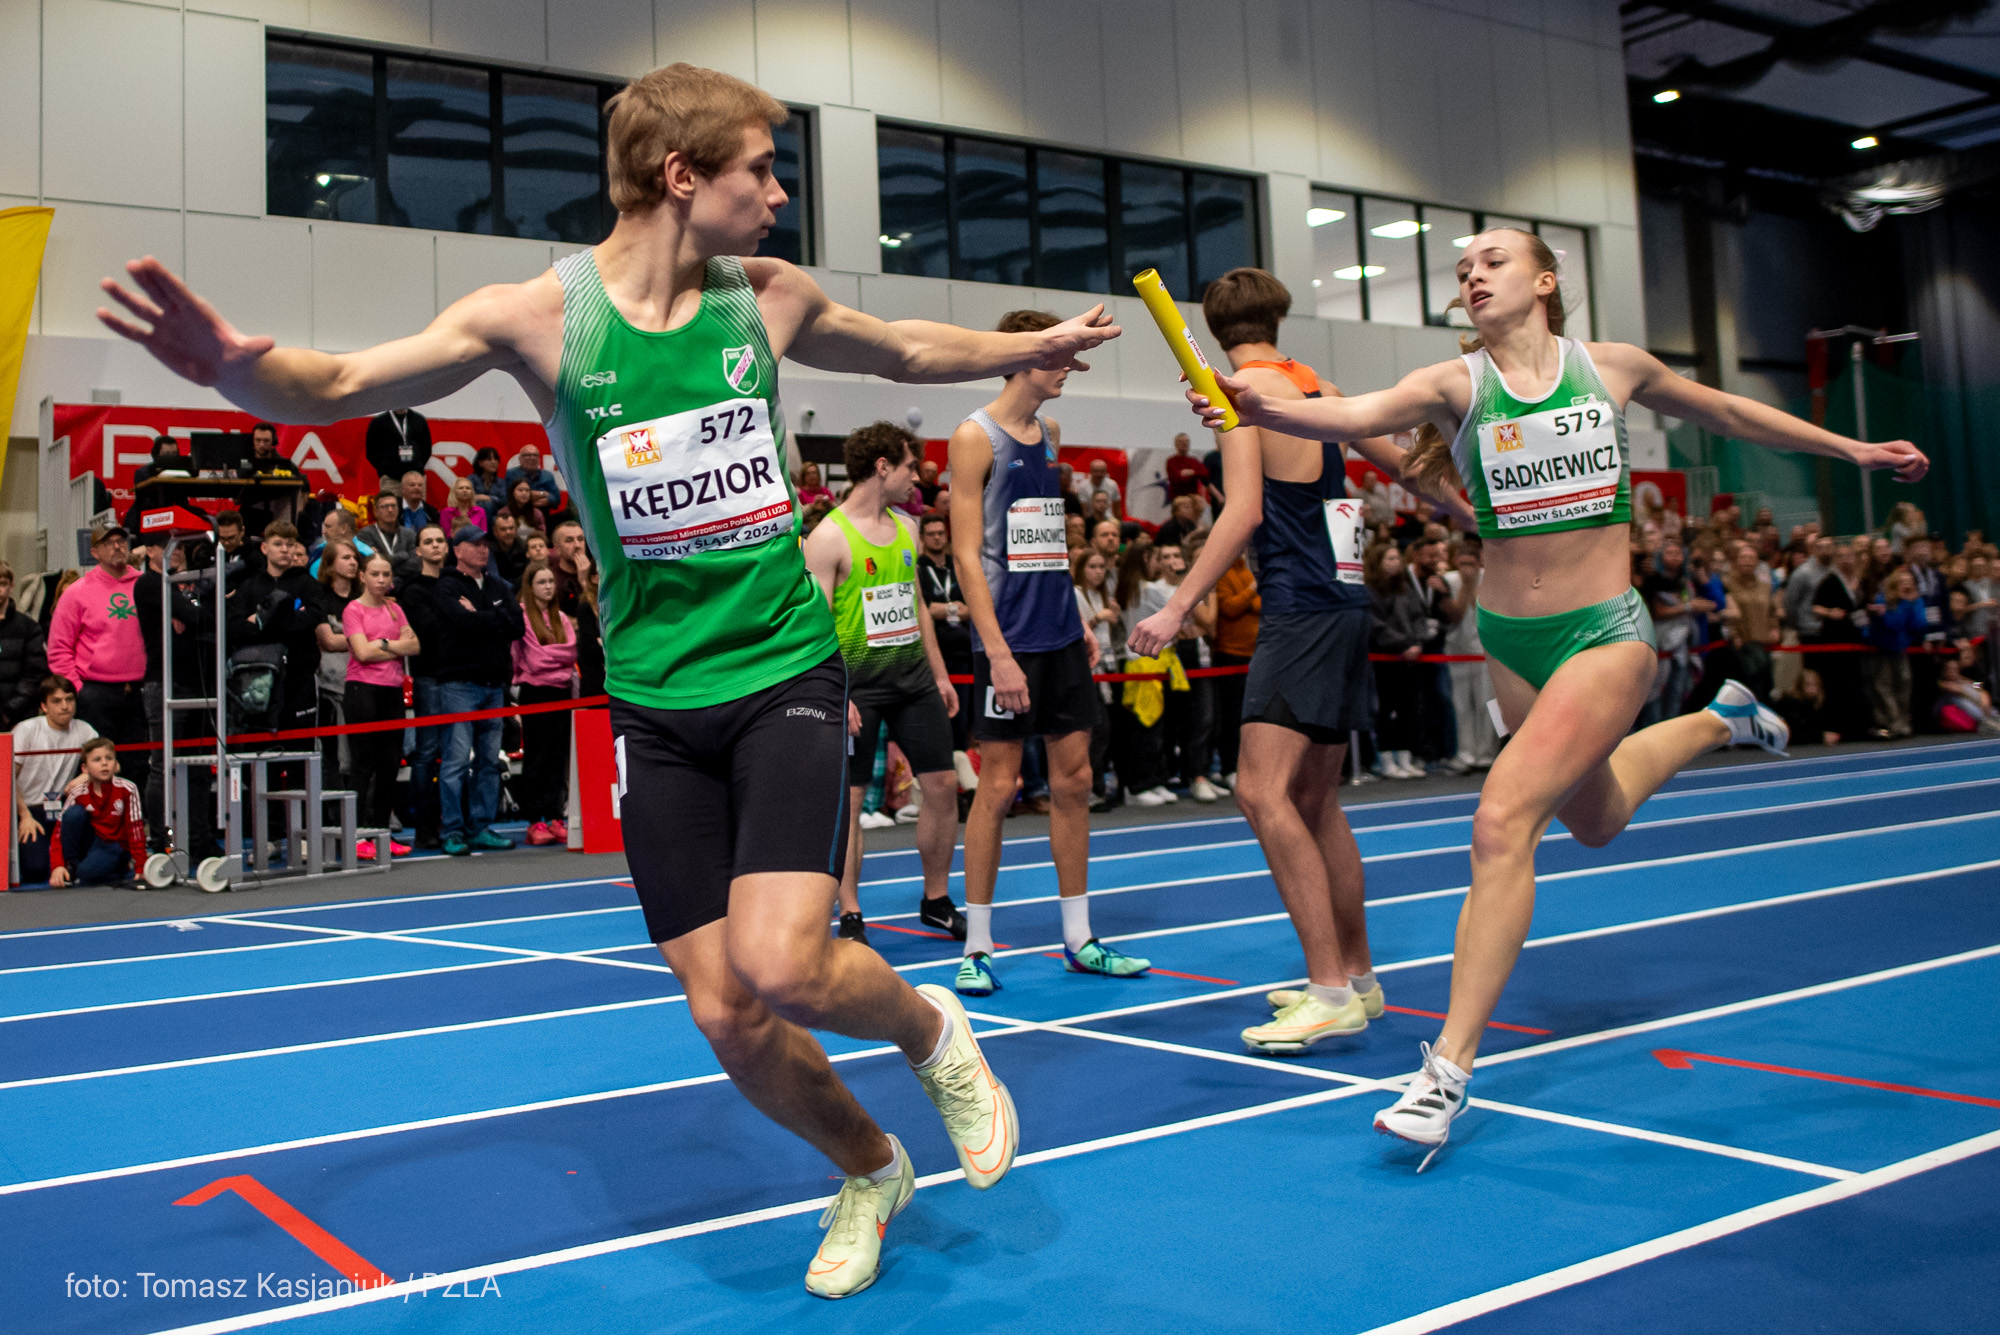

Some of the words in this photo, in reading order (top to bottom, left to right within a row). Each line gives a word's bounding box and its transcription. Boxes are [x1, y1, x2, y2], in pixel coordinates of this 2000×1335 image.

[580, 370, 617, 389] esa
[585, 403, 623, 420] TLC
[699, 405, 756, 444] 572
[1554, 408, 1602, 436] 579
[627, 450, 660, 466] PZLA
[1491, 445, 1618, 491] SADKIEWICZ
[619, 455, 775, 520] KĘDZIOR
[1538, 495, 1579, 507] Mistrzostwa
[1578, 489, 1599, 499] Polski
[679, 521, 729, 539] Mistrzostwa
[729, 514, 754, 528] Polski
[753, 510, 768, 521] U18
[771, 504, 788, 515] U20
[1509, 511, 1549, 525] DOLNY
[1551, 504, 1589, 519] ŚLĄSK
[1591, 499, 1613, 511] 202
[641, 543, 691, 557] DOLNY
[694, 531, 741, 549] ŚLĄSK
[743, 522, 779, 541] 2024
